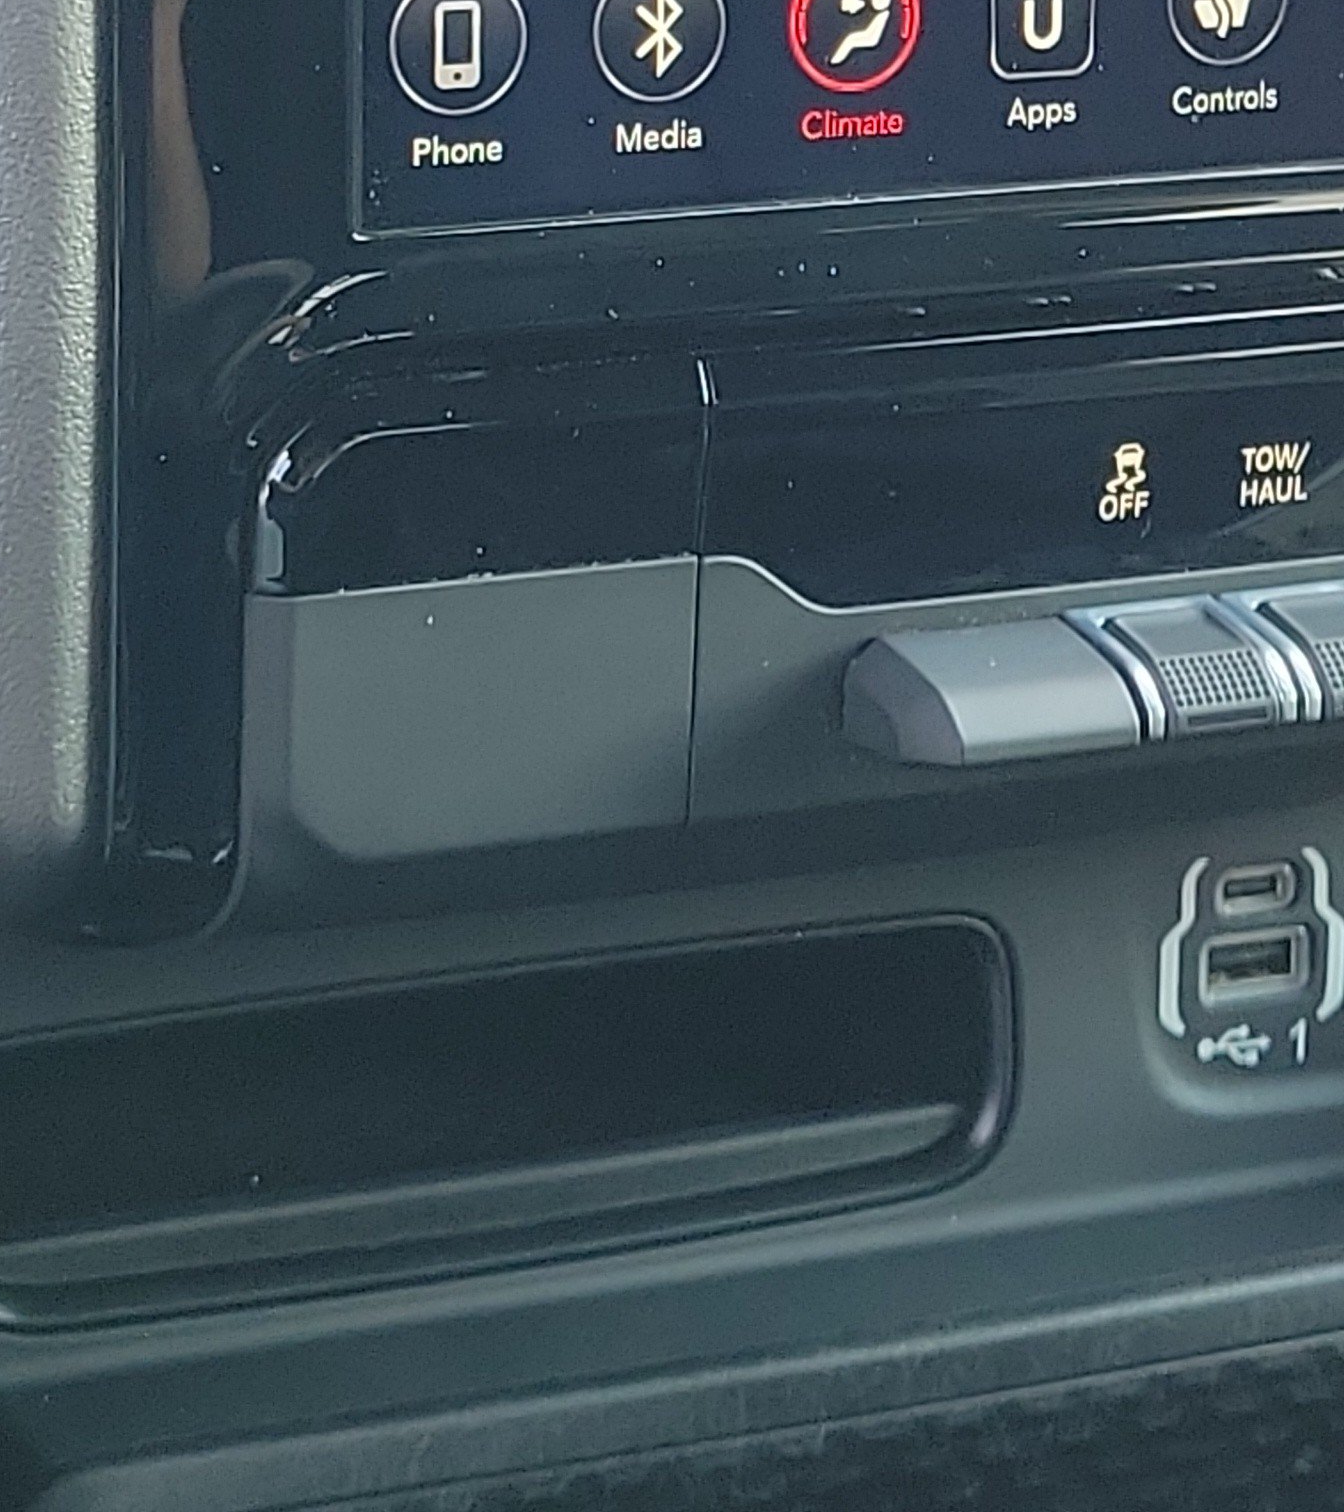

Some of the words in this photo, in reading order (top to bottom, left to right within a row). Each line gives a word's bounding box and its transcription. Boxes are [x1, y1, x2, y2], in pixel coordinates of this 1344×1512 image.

[1007, 96, 1078, 130] Apps
[1172, 81, 1279, 116] Controls
[616, 121, 703, 154] Media
[801, 110, 904, 142] Climate
[412, 137, 504, 167] Phone
[1241, 441, 1312, 476] TOW/
[1098, 491, 1150, 522] OFF
[1239, 476, 1308, 508] HAUL
[1288, 1017, 1308, 1066] 1
